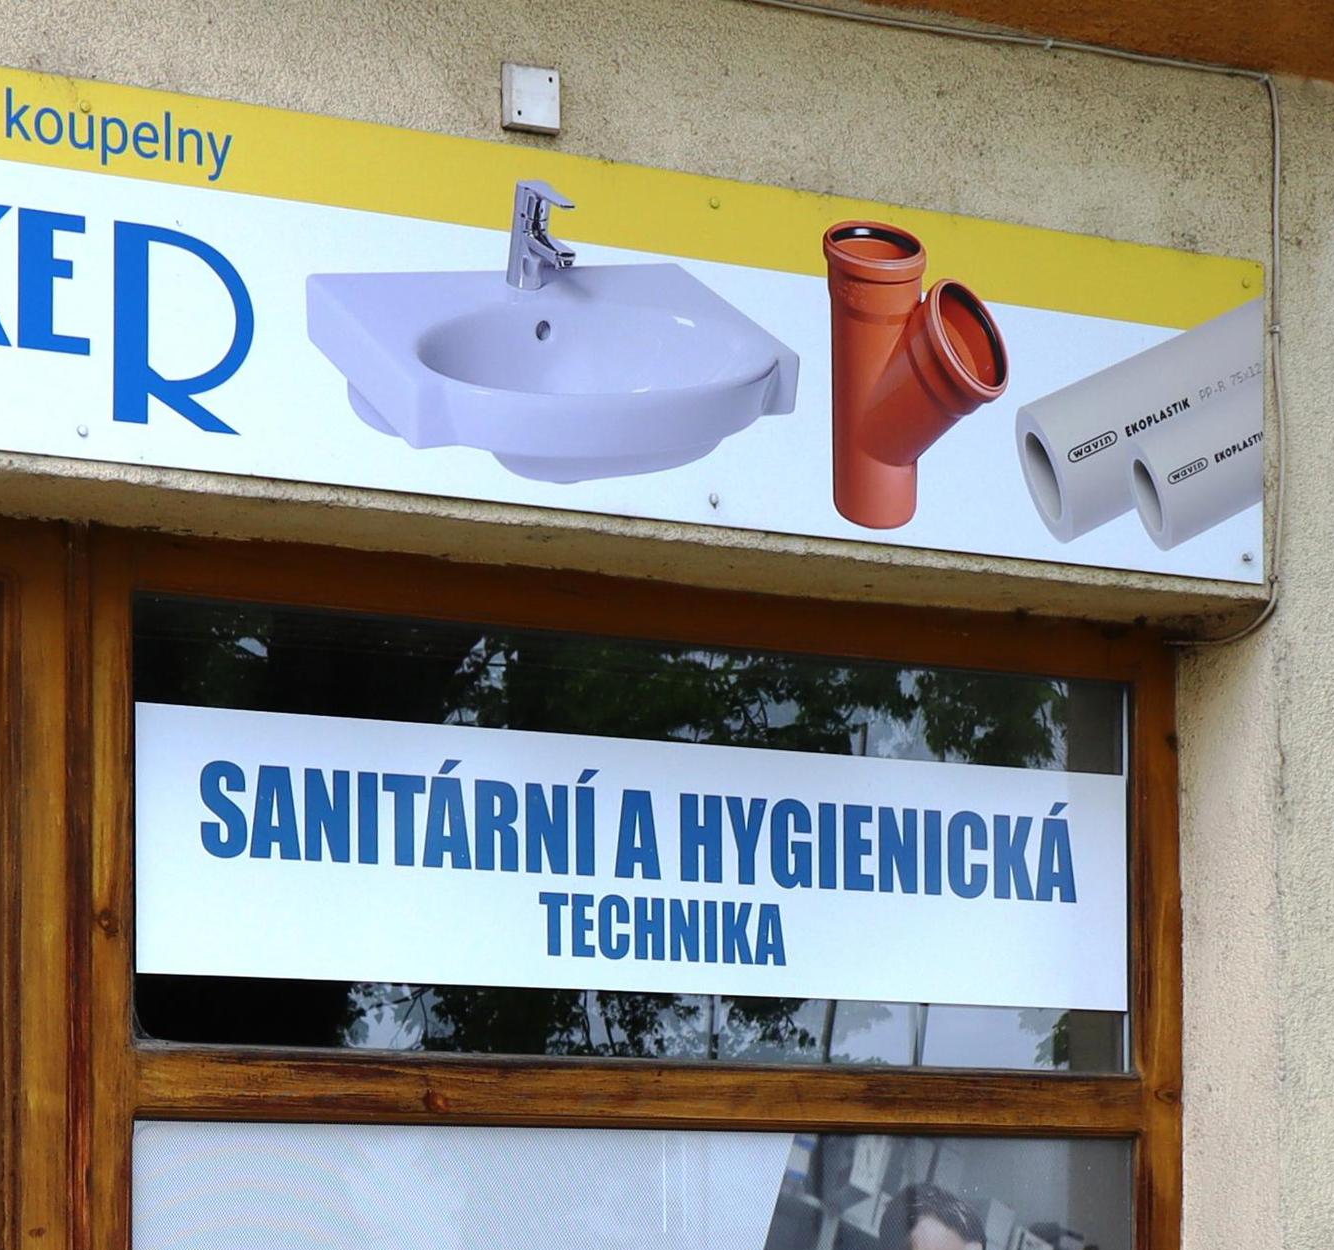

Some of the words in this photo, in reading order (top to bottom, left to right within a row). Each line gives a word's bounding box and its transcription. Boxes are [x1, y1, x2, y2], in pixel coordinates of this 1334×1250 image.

[6, 87, 233, 181] koupelny
[1073, 434, 1113, 459] wavin
[1125, 398, 1191, 437] EKOPLASTIK
[1172, 462, 1205, 481] wavin
[1215, 432, 1263, 463] EKOPLASTI
[200, 758, 599, 877] SANITÁRNÍ
[615, 789, 661, 880] A
[680, 792, 1076, 903] HYGIENICKÁ
[539, 891, 786, 967] TECHNIKA
